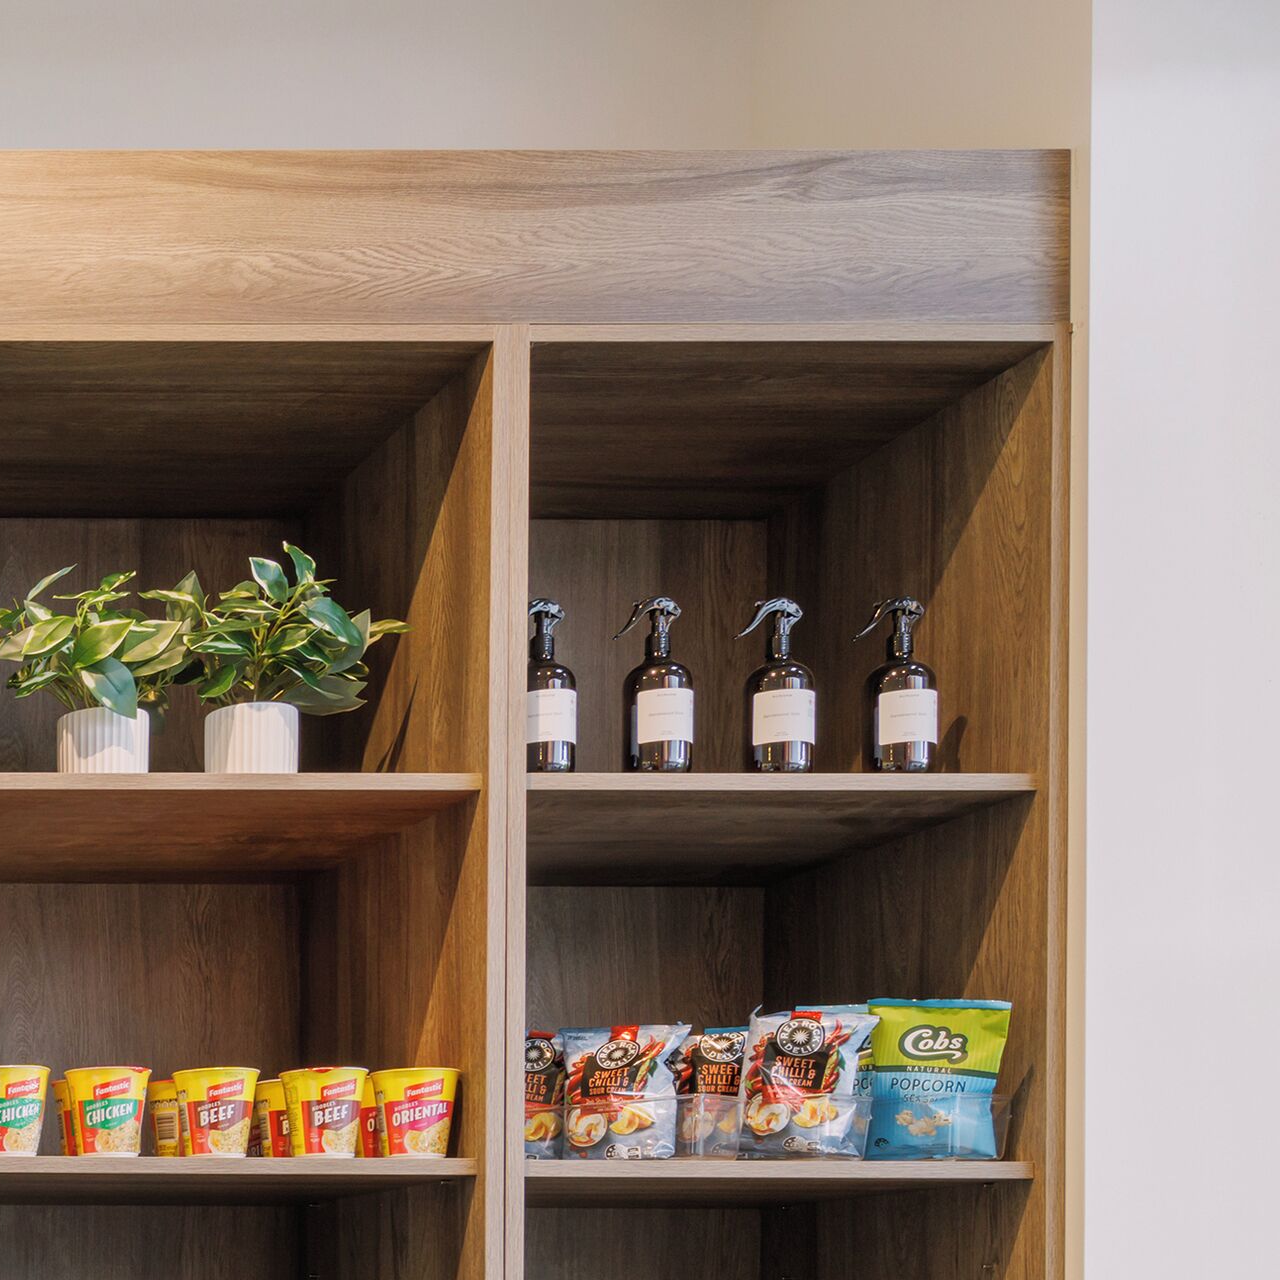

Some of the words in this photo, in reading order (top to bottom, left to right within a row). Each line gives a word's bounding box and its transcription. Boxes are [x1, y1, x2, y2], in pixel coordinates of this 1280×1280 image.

[784, 1043, 811, 1054] DELI
[903, 1028, 964, 1060] Cobs
[604, 1058, 627, 1068] DELI
[775, 1056, 816, 1069] SWEET
[593, 1067, 630, 1079] SWEET
[702, 1064, 739, 1075] SWEET
[771, 1065, 806, 1079] CHILLI
[807, 1069, 816, 1080] &
[906, 1065, 952, 1074] NATURAL
[526, 1073, 548, 1083] EET
[589, 1077, 621, 1088] CHILLI
[698, 1074, 732, 1085] CHILLI
[789, 1078, 813, 1088] CREAM
[95, 1080, 130, 1096] Fantastic
[209, 1083, 243, 1097] Fantastic
[323, 1082, 356, 1097] Fantastic
[406, 1083, 442, 1097] Fantastic
[697, 1085, 716, 1093] SOUR
[891, 1077, 967, 1093] POPCORN
[197, 1101, 221, 1111] NOODLES
[311, 1101, 336, 1111] NOODLES
[394, 1101, 418, 1111] NOODLES
[86, 1103, 133, 1126] CHICKEN
[200, 1104, 235, 1127] BEEF
[314, 1104, 349, 1127] BEEF
[392, 1102, 448, 1126] ORIENTAL
